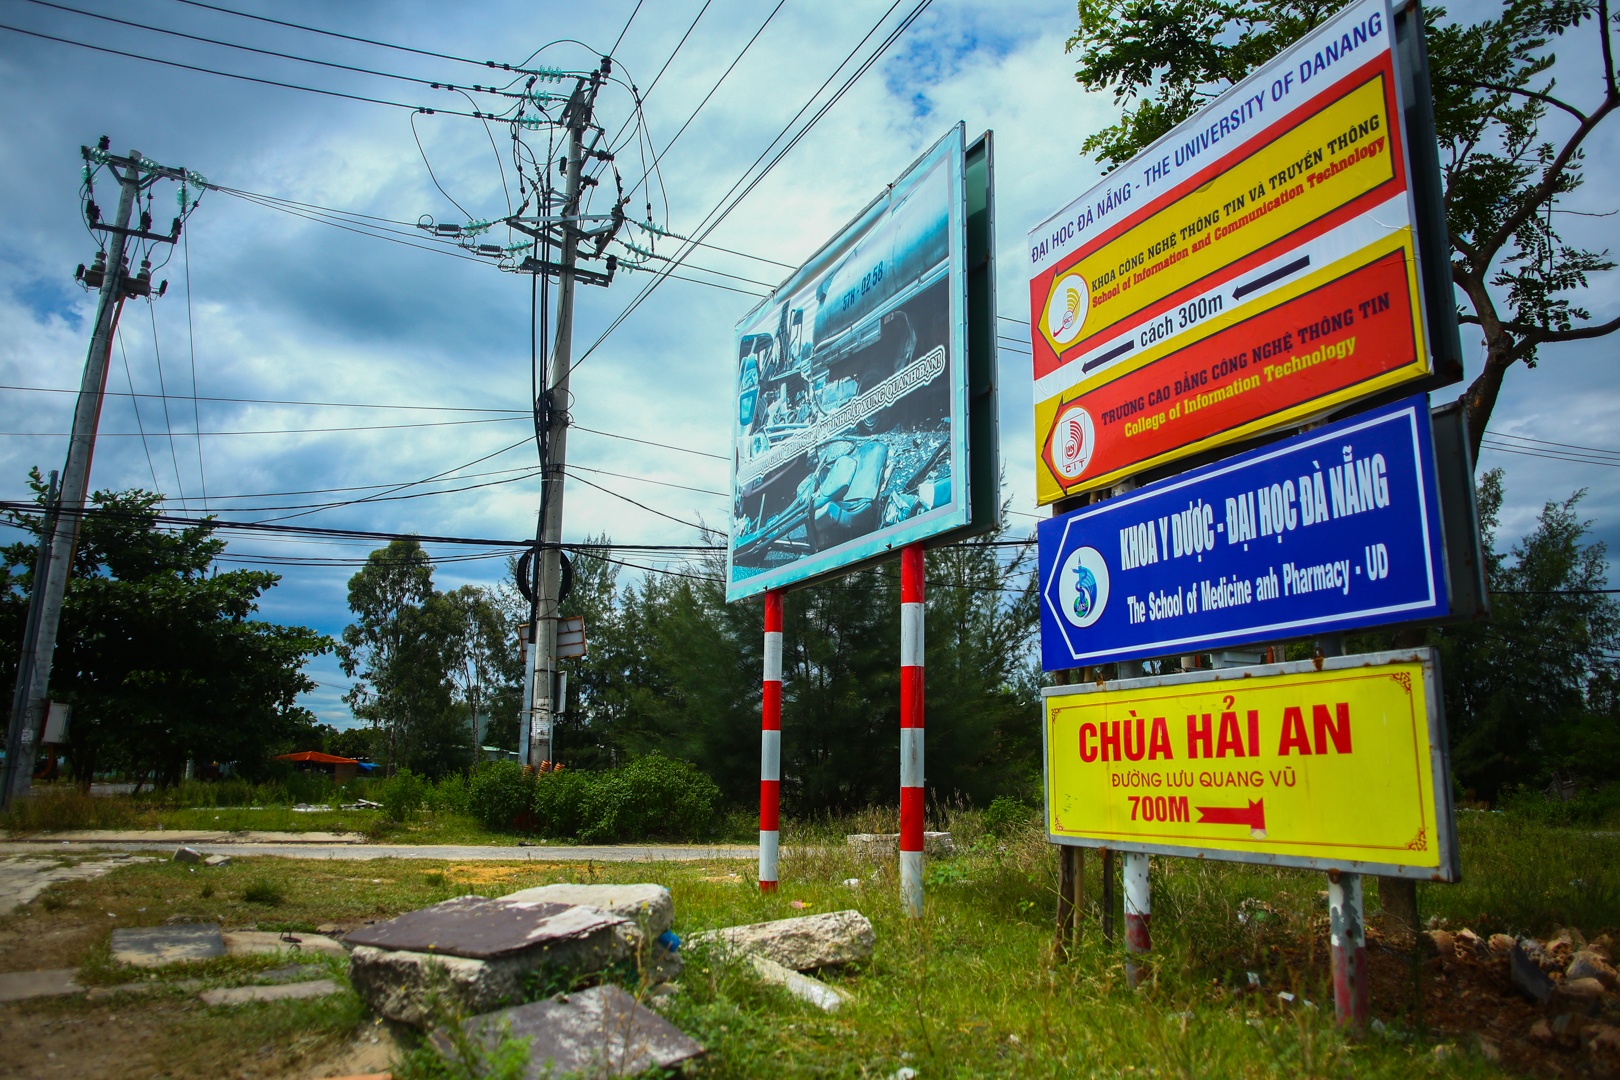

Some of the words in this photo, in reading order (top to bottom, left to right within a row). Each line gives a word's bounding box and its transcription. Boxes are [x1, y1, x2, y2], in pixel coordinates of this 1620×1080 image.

[1031, 238, 1049, 263] ĐẠI
[1052, 221, 1074, 249] HỌC
[1077, 206, 1094, 232] ĐÀ
[1143, 156, 1171, 187] THE
[1174, 90, 1265, 167] UNIVERSITY
[1271, 70, 1294, 102] OF
[1300, 12, 1382, 85] DANANG
[1091, 269, 1116, 292] KHOA
[1118, 251, 1145, 277] CÔNG
[1147, 231, 1177, 259] NGHỆ
[1179, 210, 1220, 241] THÔNG
[1223, 195, 1245, 217] TIN
[1248, 181, 1266, 203] VÀ
[1268, 148, 1323, 190] TRUYỀN
[1327, 114, 1380, 156] THÔNG
[1092, 284, 1120, 308] School
[1122, 277, 1131, 291] of
[1133, 247, 1189, 286] Information
[1191, 233, 1211, 253] and
[1214, 183, 1304, 241] Communication
[1306, 136, 1385, 189] Technology
[861, 272, 871, 296] 02
[872, 260, 884, 287] 58
[1140, 316, 1173, 347] cách
[1178, 293, 1223, 329] 300m
[1148, 385, 1171, 407] CAO
[1211, 353, 1248, 380] CÔNG
[1252, 331, 1293, 364] NGHỆ
[1297, 308, 1354, 344] THÔNG
[1358, 292, 1390, 319] TIN
[861, 391, 885, 413] XUNG
[885, 371, 918, 400] QUANH
[1124, 412, 1166, 438] College
[1168, 402, 1181, 420] of
[1183, 374, 1261, 415] Information
[1263, 336, 1356, 383] Technology
[1119, 520, 1159, 571] KHOA
[1158, 516, 1169, 561] Y
[1171, 498, 1215, 563] DƯỢC
[1225, 491, 1257, 552] ĐẠI
[1257, 480, 1298, 544] HỌC
[1298, 460, 1330, 527] ĐÀ
[1329, 445, 1390, 519] NẴNG
[1127, 596, 1146, 624] The
[1149, 586, 1183, 621] School
[1186, 582, 1198, 614] of
[1200, 574, 1252, 612] Medicine
[1256, 566, 1279, 601] anh
[1282, 559, 1350, 596] Pharmacy
[1365, 543, 1389, 581] UD
[1078, 710, 1174, 763] CHÙA
[1186, 695, 1261, 759] HẢI
[1278, 702, 1353, 757] AN
[1112, 769, 1162, 788] ĐƯỜNG
[1166, 769, 1194, 788] LƯU
[1199, 770, 1265, 788] QUANG
[1269, 766, 1297, 788] VŨ
[1127, 795, 1191, 823] 700M
